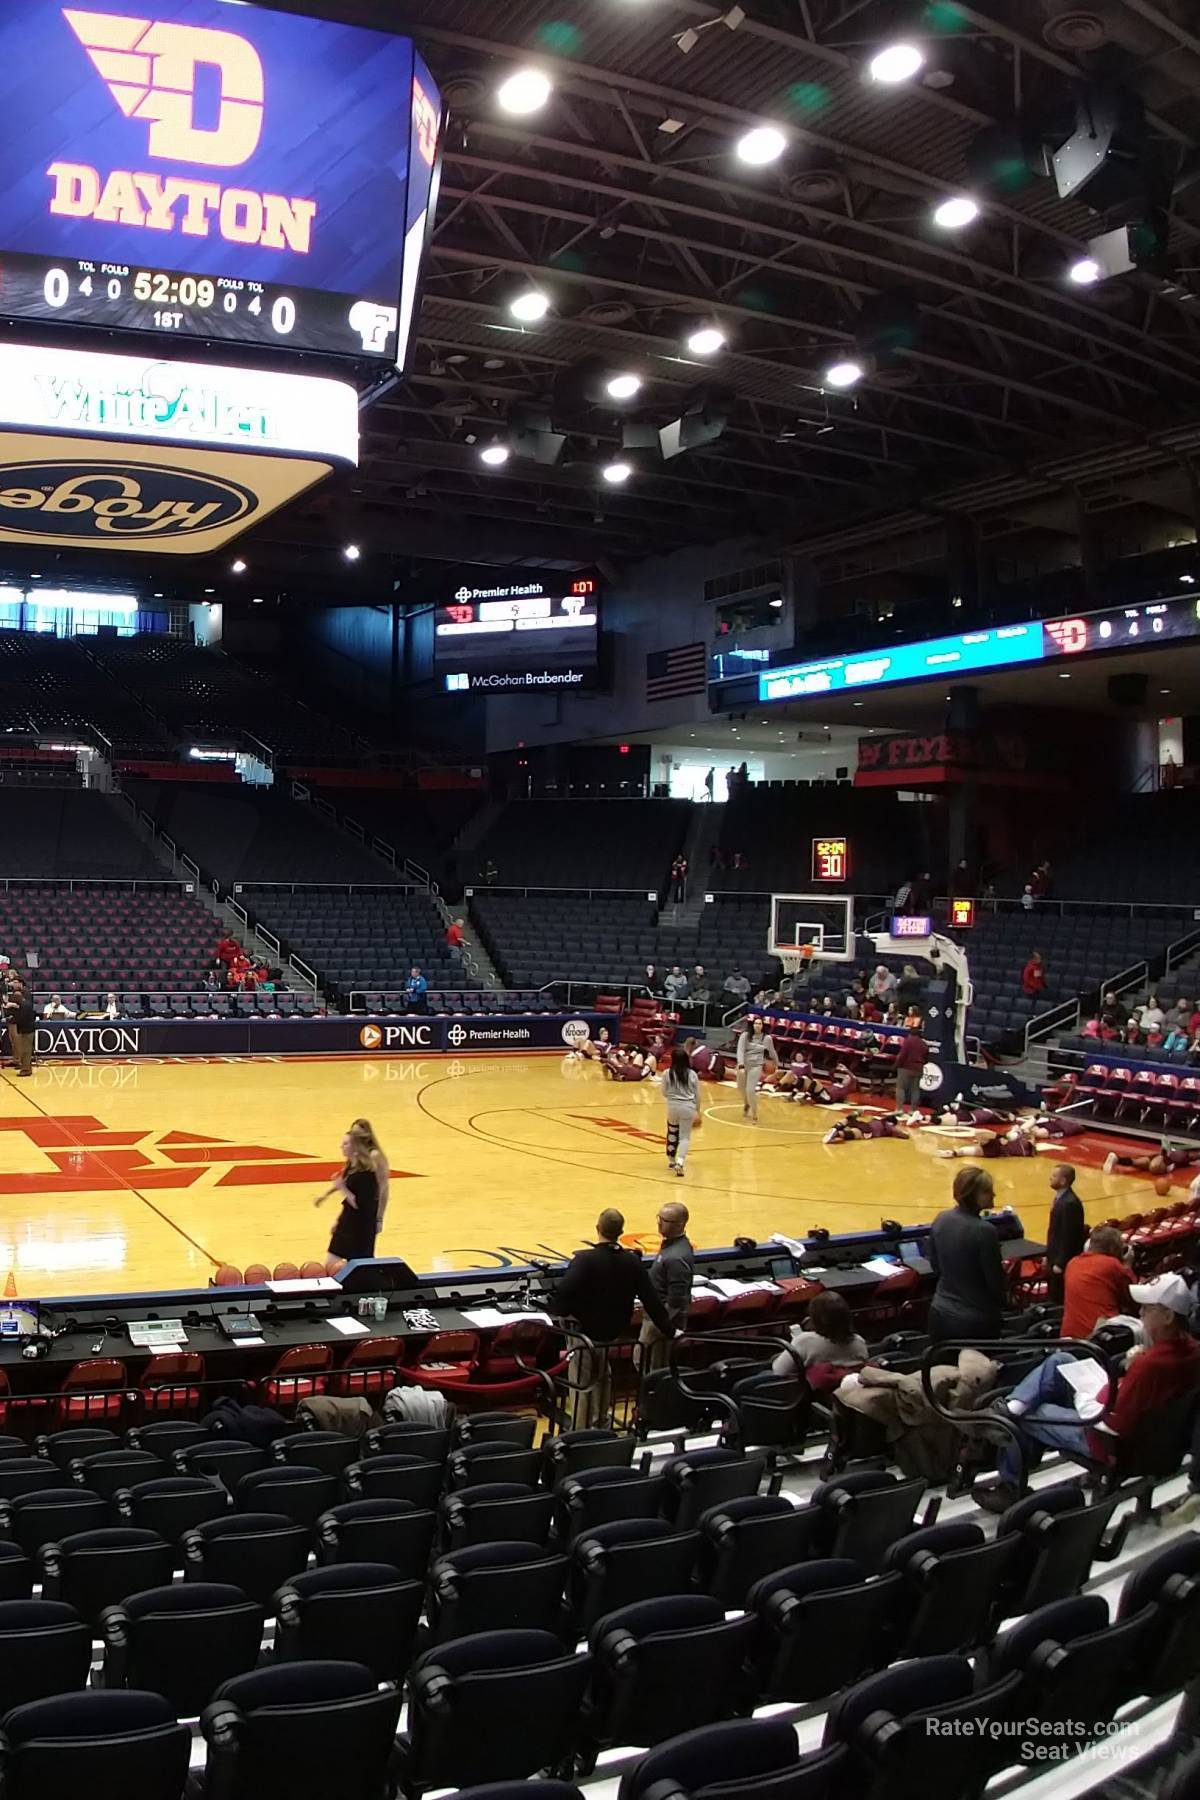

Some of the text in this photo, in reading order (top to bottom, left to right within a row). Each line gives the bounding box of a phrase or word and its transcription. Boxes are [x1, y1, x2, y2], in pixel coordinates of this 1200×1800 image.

[46, 161, 317, 254] DAYTON
[78, 261, 129, 276] TOL FOULS
[44, 268, 215, 308] 0 4 0 52:09
[217, 277, 264, 293] FOULS TOL
[153, 311, 184, 329] 1ST
[223, 292, 296, 334] 0 4 0
[472, 583, 543, 599] Premier Health
[821, 855, 841, 877] 30
[34, 1028, 140, 1053] DAYTON
[385, 1026, 431, 1046] PNC
[469, 1028, 530, 1040] Premier Health
